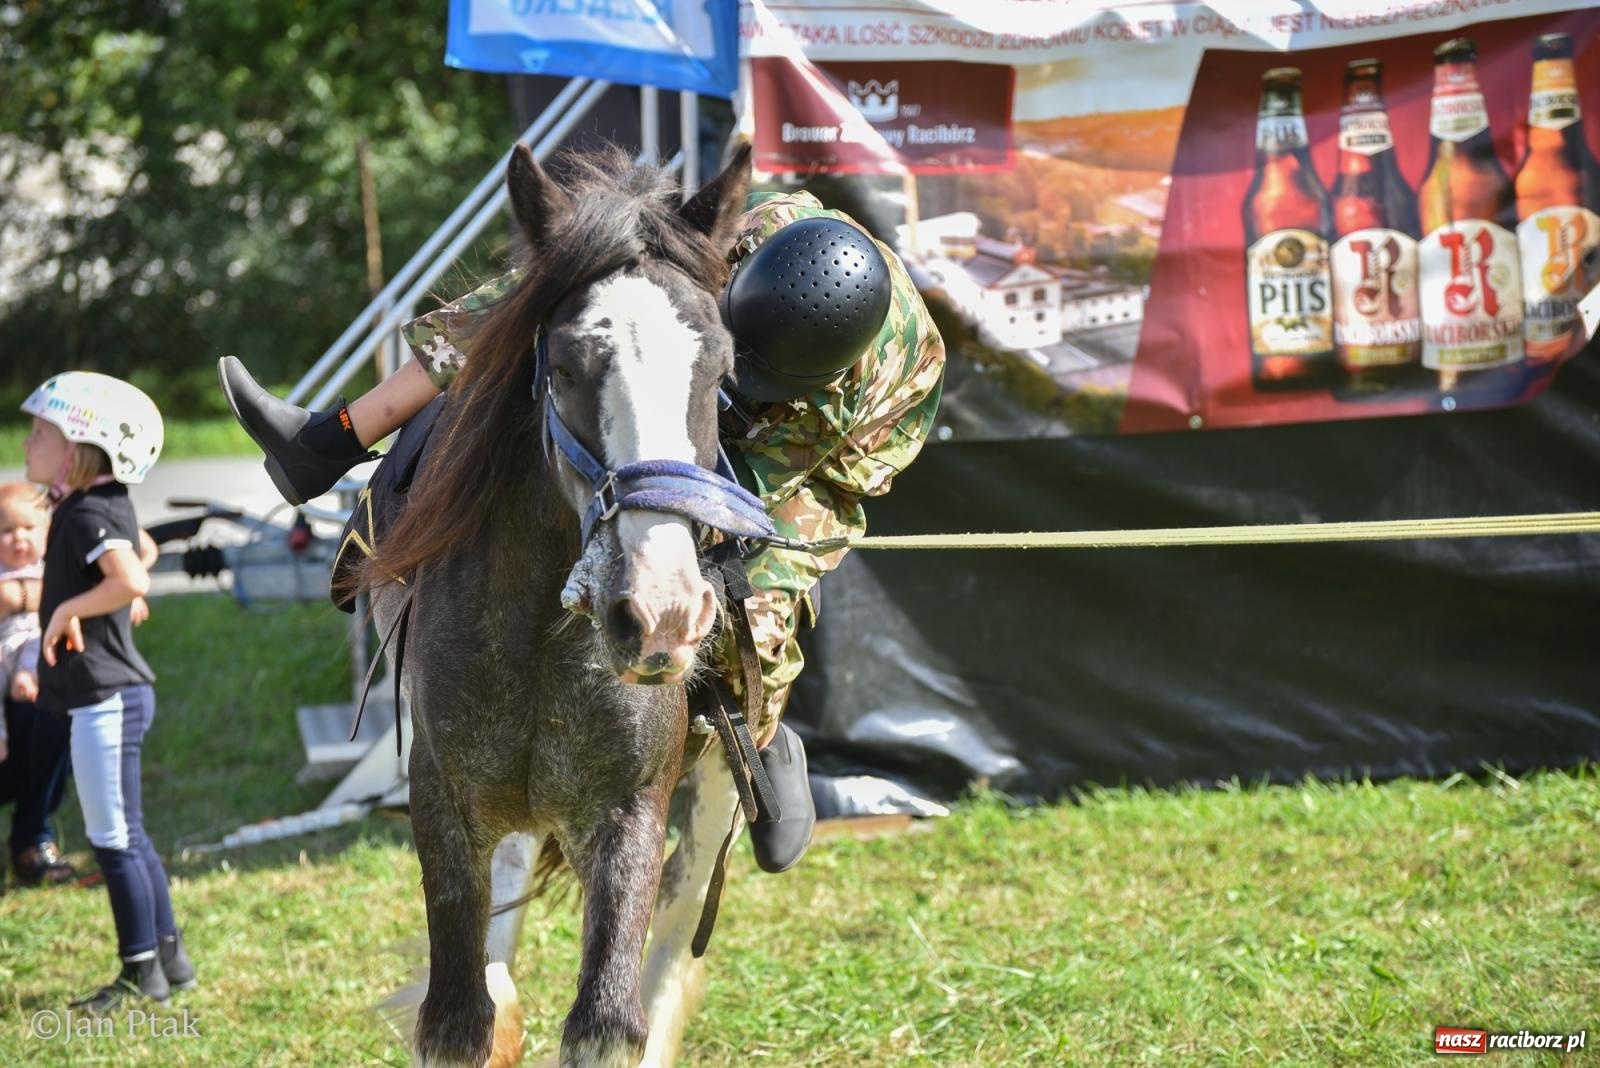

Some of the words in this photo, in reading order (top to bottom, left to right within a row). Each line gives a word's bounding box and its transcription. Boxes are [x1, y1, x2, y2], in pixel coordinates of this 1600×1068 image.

[790, 23, 840, 44] TAKA
[843, 20, 904, 45] ILOŚĆ
[907, 23, 994, 49] SZKODZI
[1091, 20, 1163, 41] KOBET
[907, 123, 976, 145] Racibórz
